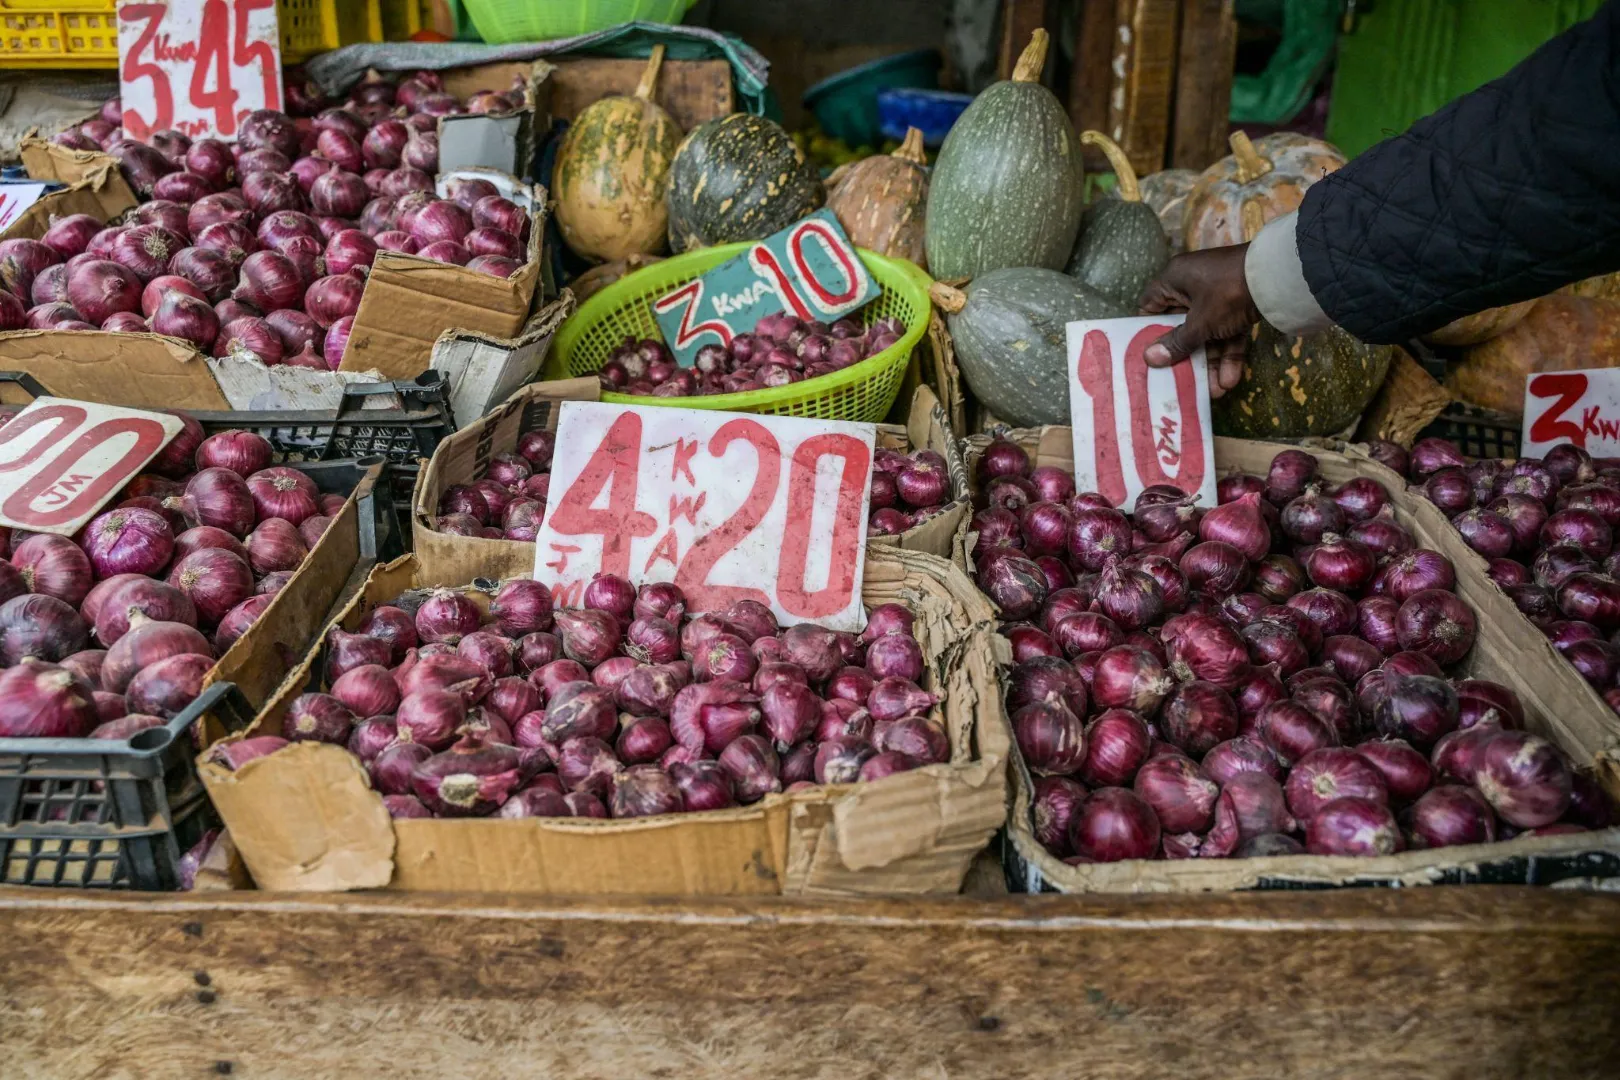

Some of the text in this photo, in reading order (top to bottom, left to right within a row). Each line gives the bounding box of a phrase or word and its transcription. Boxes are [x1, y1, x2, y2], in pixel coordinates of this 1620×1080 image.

[118, 3, 174, 143] 3
[189, 0, 280, 136] 45
[748, 218, 868, 323] 10
[1078, 324, 1205, 508] 10
[1582, 405, 1620, 441] KW
[40, 474, 93, 505] JM
[548, 410, 659, 581] 4
[673, 418, 870, 619] 20
